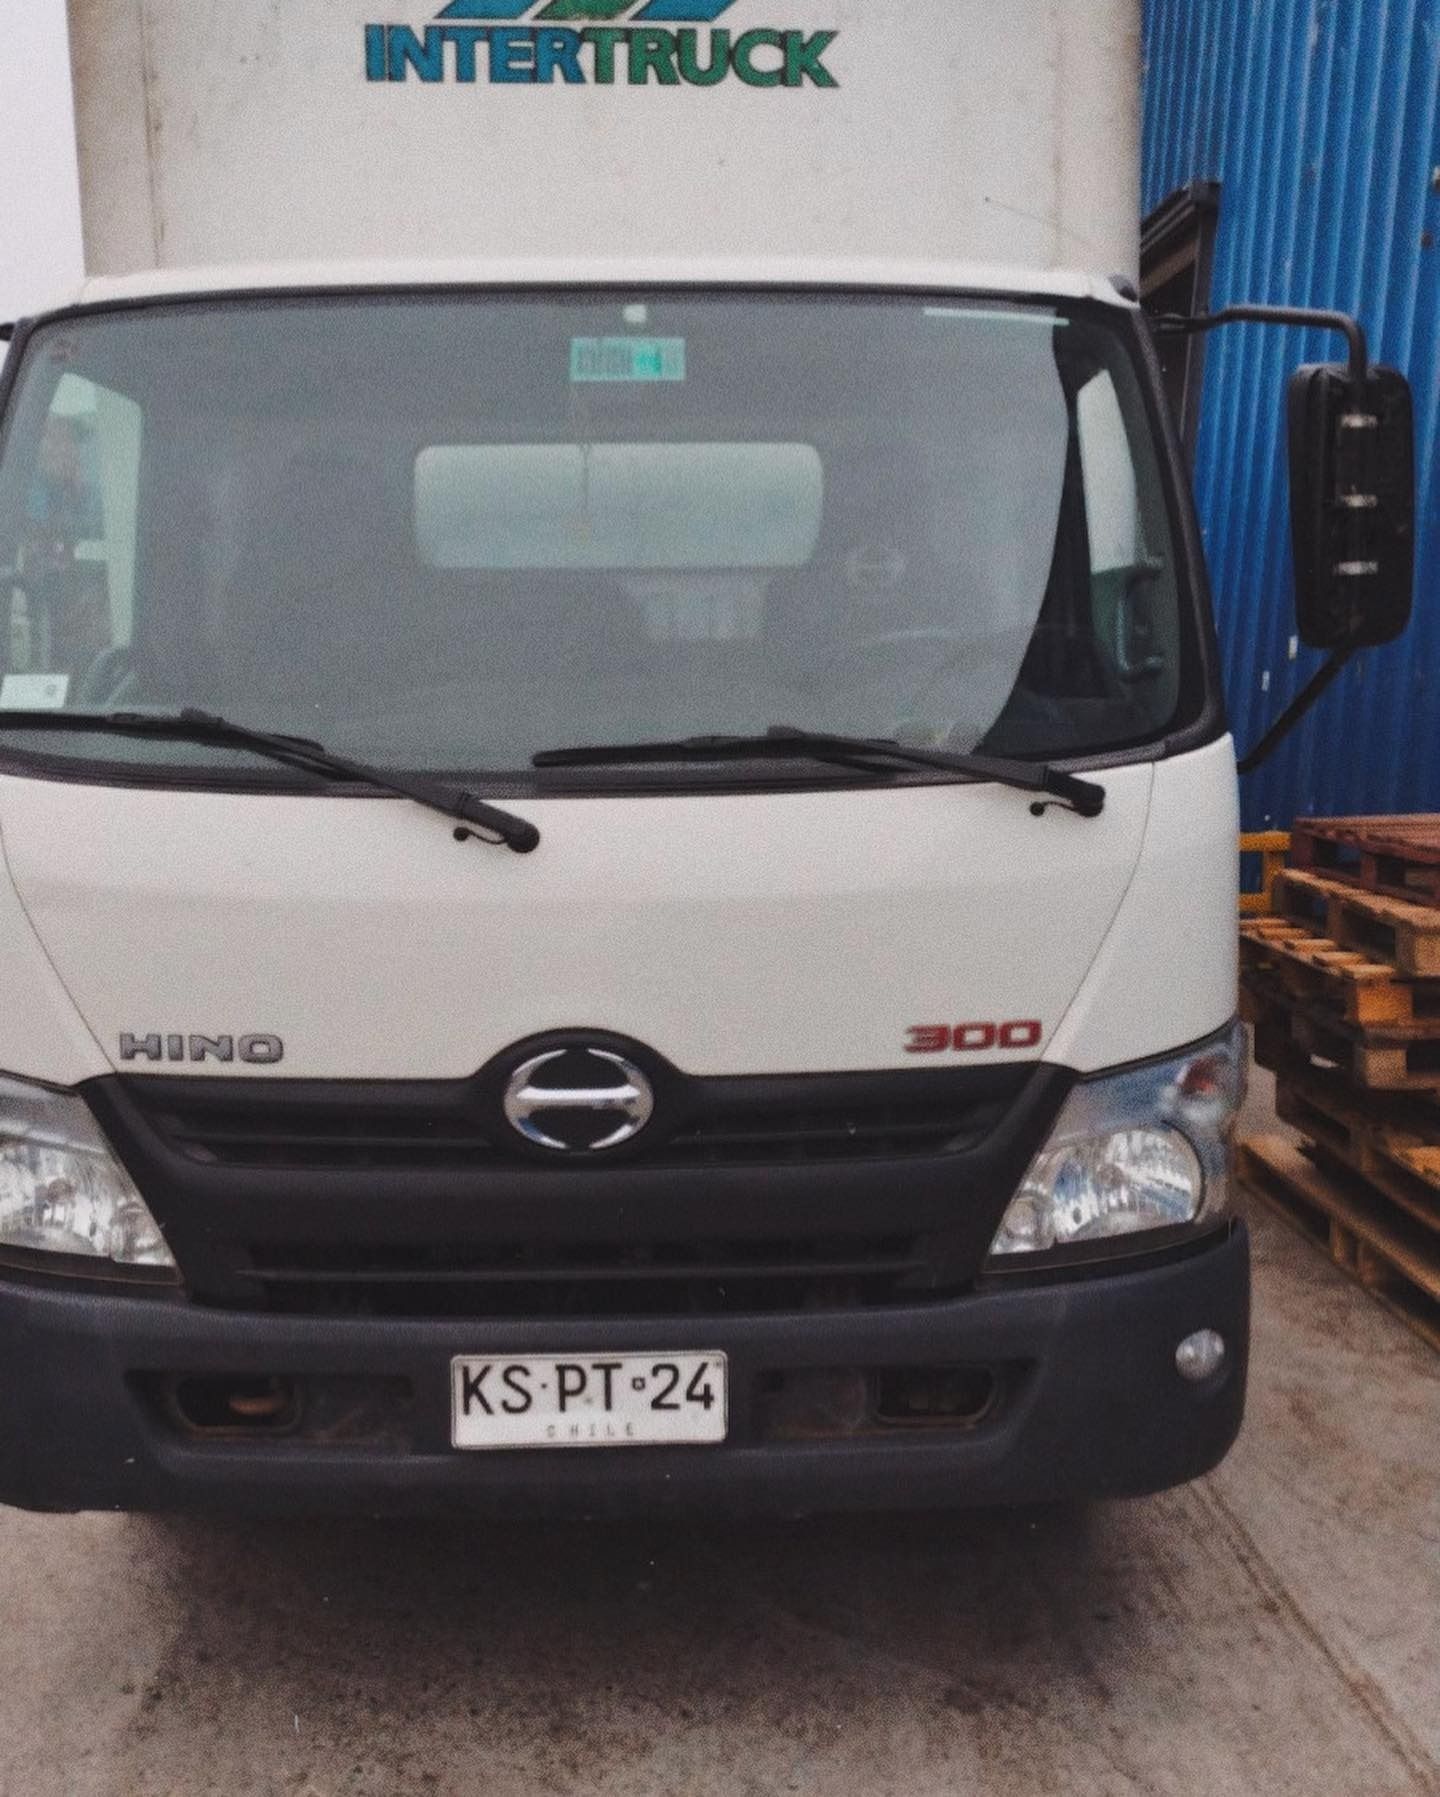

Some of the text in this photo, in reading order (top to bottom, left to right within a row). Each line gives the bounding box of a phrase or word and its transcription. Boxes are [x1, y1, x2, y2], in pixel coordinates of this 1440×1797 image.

[364, 23, 840, 88] INTERTRUCK
[119, 1032, 285, 1065] HINO
[903, 1019, 1043, 1054] 300
[546, 1421, 635, 1439] CHILE
